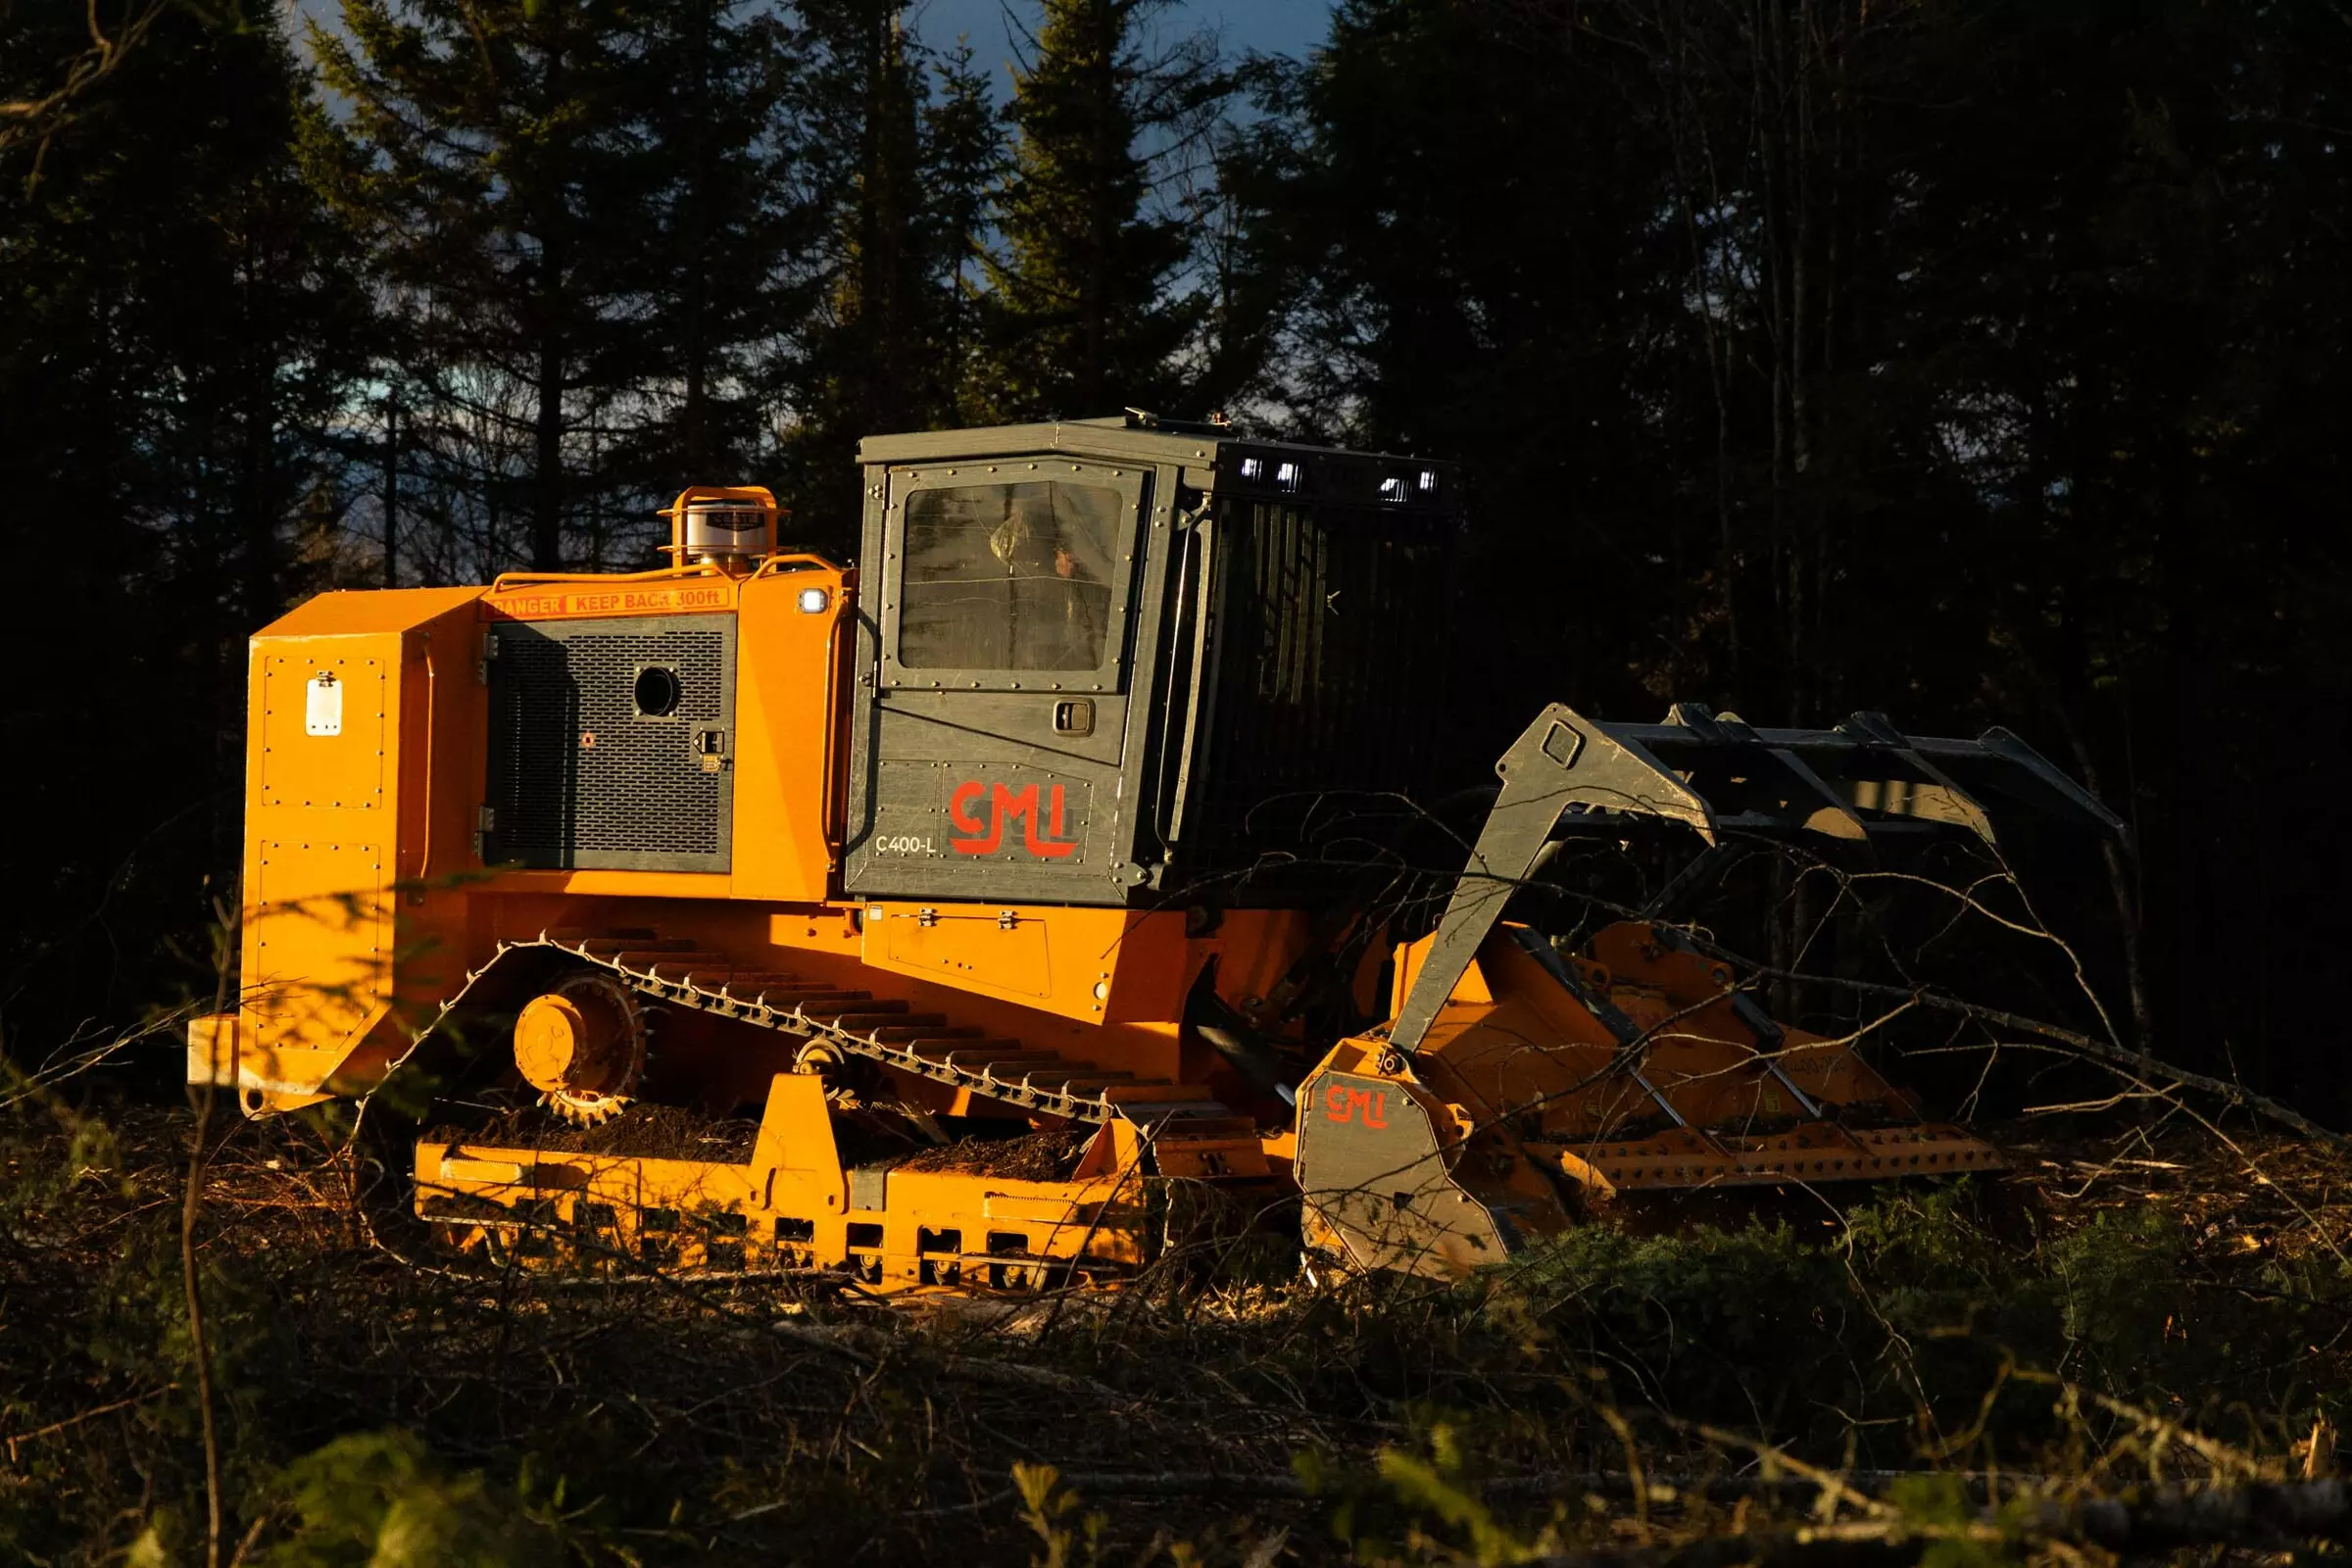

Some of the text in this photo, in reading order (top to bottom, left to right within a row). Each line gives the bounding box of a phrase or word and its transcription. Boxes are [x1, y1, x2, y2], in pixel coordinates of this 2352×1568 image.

[493, 597, 561, 614] DANGER
[576, 595, 620, 612] KEEP
[676, 589, 719, 606] 300ft
[875, 836, 936, 854] C400-L
